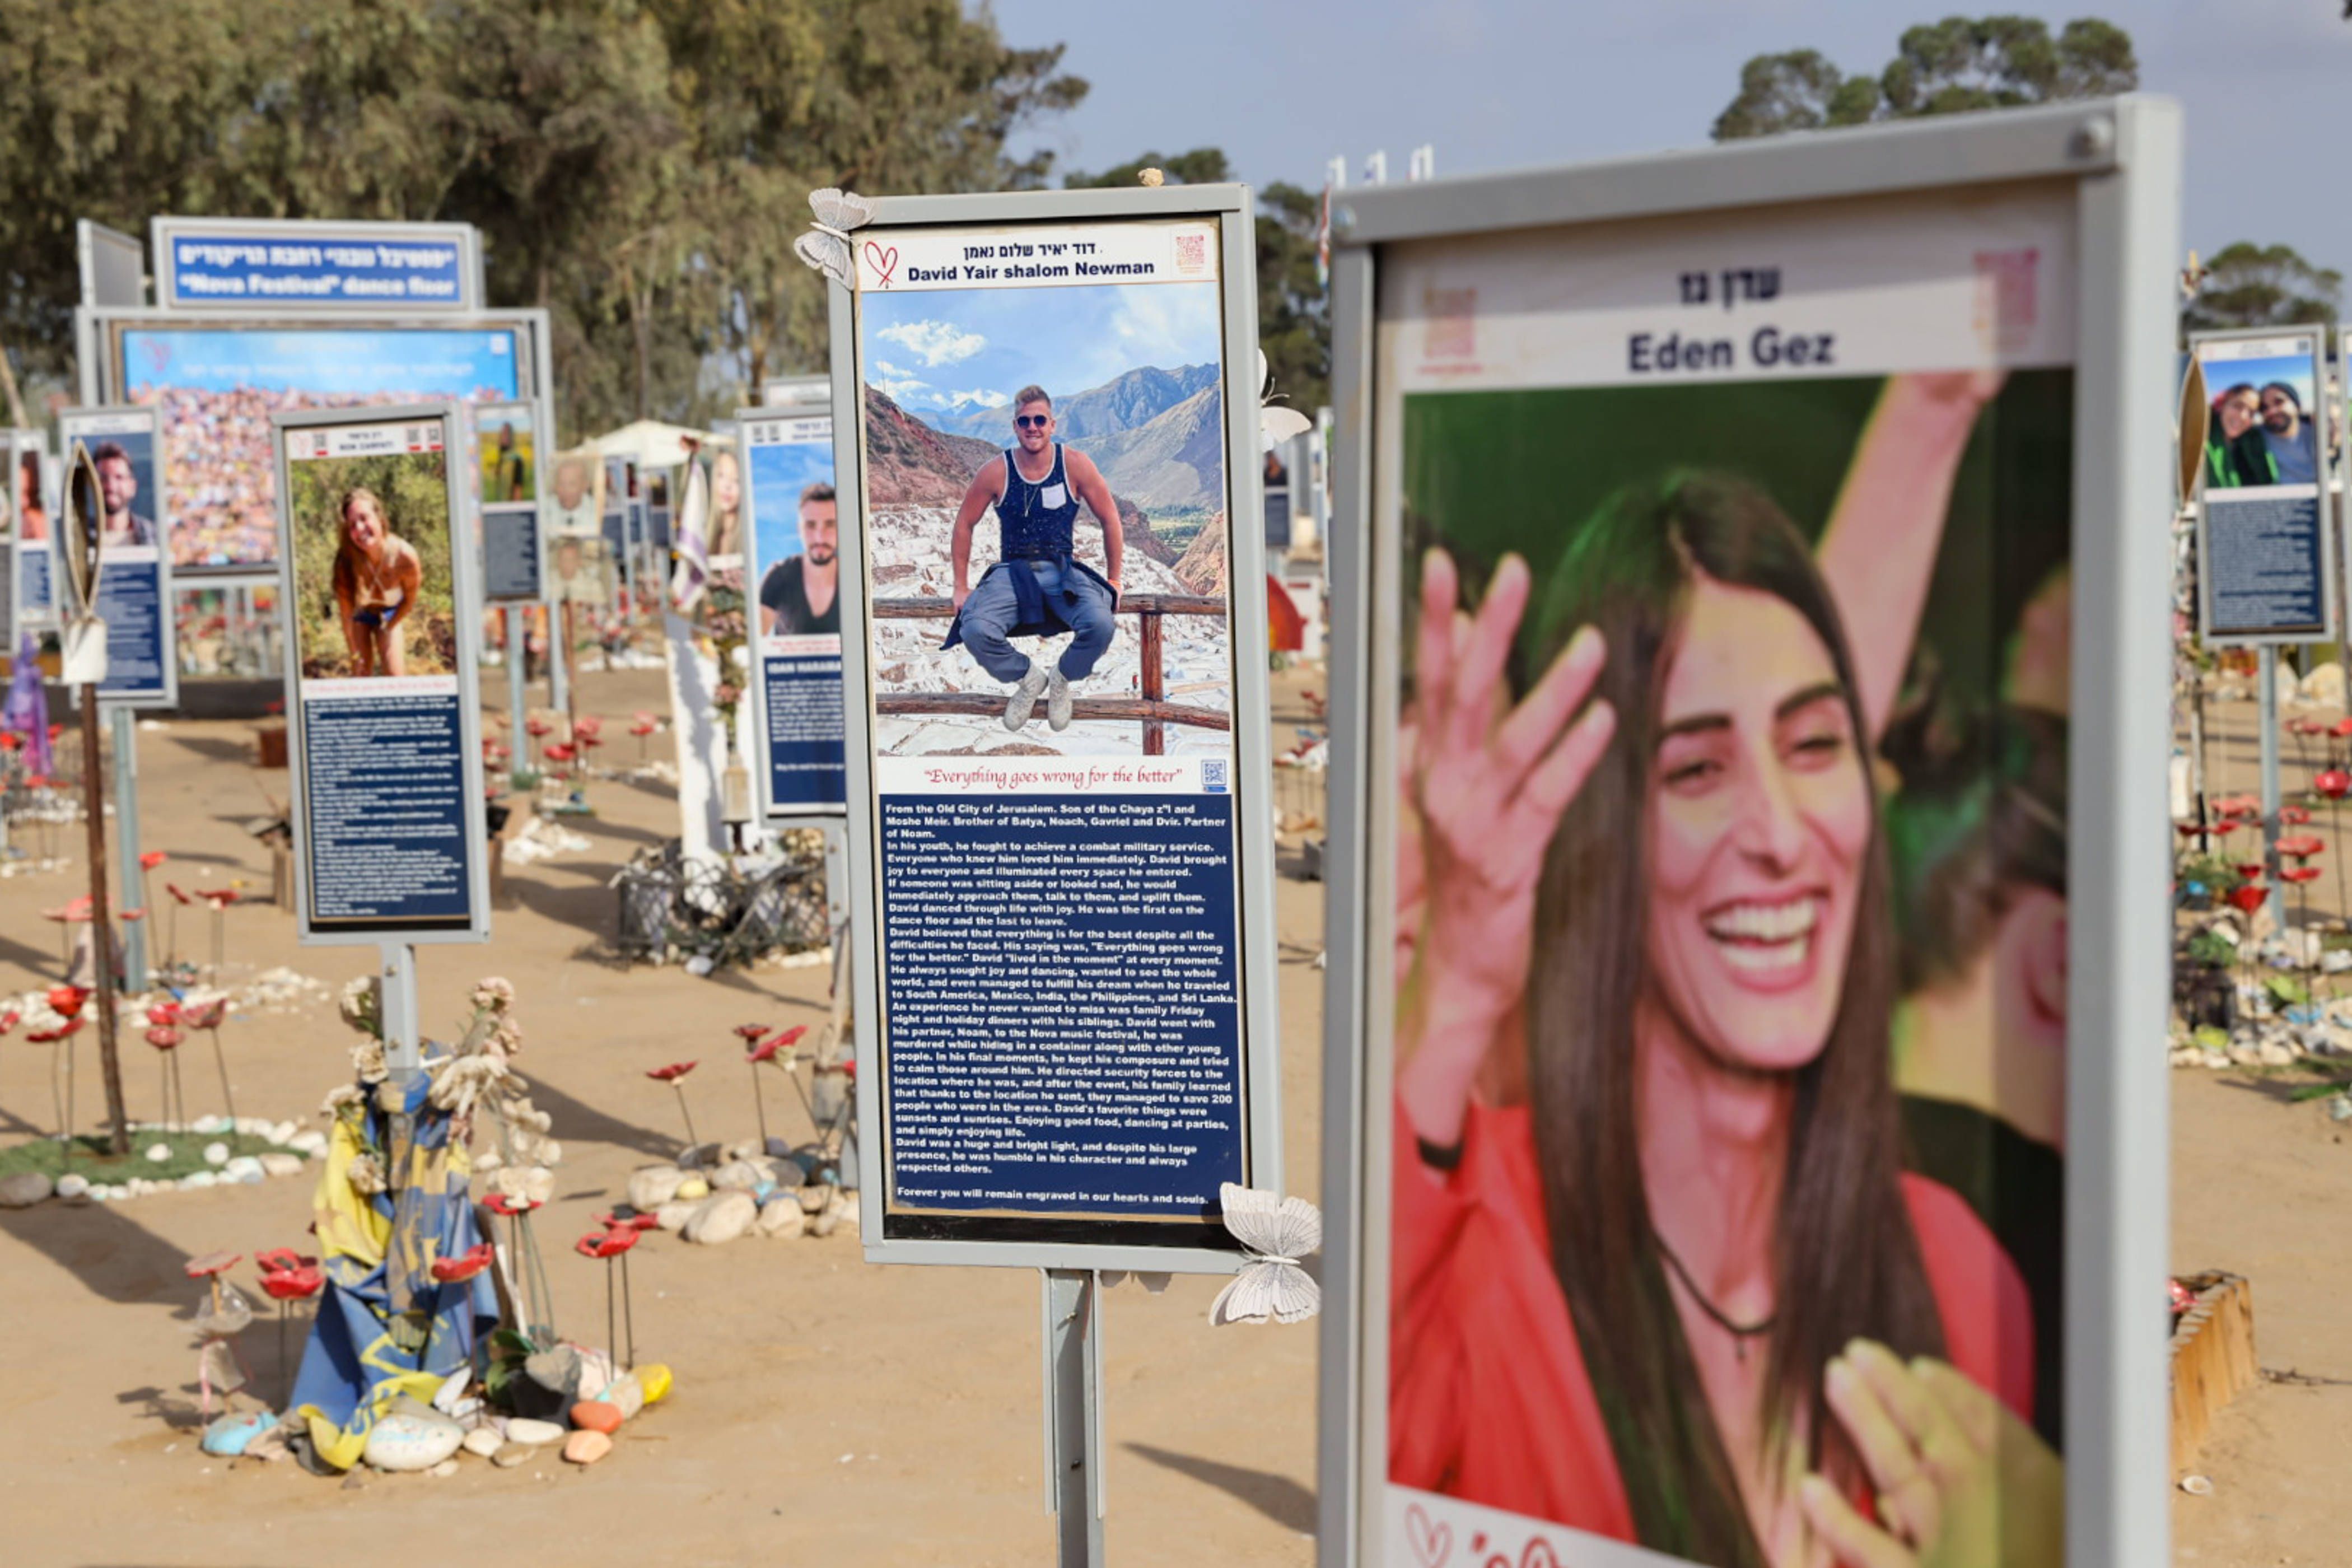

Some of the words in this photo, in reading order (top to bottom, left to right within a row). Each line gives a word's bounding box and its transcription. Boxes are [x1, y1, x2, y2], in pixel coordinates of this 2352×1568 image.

[964, 246, 993, 260] נאמן
[1000, 243, 1033, 257] שלום
[1038, 244, 1067, 255] יאיר
[1072, 244, 1095, 254] דוד
[909, 267, 956, 281] David
[963, 265, 998, 279] Yair
[1004, 264, 1068, 278] shalom
[1076, 262, 1154, 276] Newman
[342, 275, 405, 295] dance
[407, 274, 455, 296] floor
[1628, 328, 1733, 372] Eden
[1751, 325, 1836, 367] Gez
[923, 767, 1006, 789] "Everything
[1011, 771, 1039, 790] goes
[1043, 769, 1084, 789] wrong
[1088, 768, 1108, 790] for
[1113, 766, 1132, 782] the
[1137, 768, 1182, 783] better"
[885, 804, 914, 813] From
[916, 805, 934, 813] the
[936, 804, 955, 813] Old
[957, 804, 980, 815] City
[982, 804, 993, 813] of
[996, 804, 1057, 813] Jerusalem.
[1060, 804, 1081, 813] Son
[1083, 804, 1095, 813] of
[1098, 805, 1117, 813] the
[1119, 804, 1154, 815] Chaya
[1174, 804, 1195, 813] and
[885, 816, 921, 825] Moshe
[924, 816, 950, 825] Meir.
[953, 816, 994, 825] Brother
[996, 816, 1009, 825] of
[1049, 817, 1088, 827] Noach,
[1132, 817, 1153, 826] and
[1156, 816, 1181, 826] Dvir.
[1184, 817, 1226, 827] Partner
[886, 829, 897, 838] of
[901, 829, 935, 838] Noam.
[900, 842, 917, 850] his
[919, 842, 953, 852] youth,
[955, 842, 969, 850] he
[972, 842, 1007, 852] fought
[1009, 842, 1021, 851] to
[1024, 842, 1067, 851] achieve
[1079, 842, 1121, 851] combat
[1123, 842, 1166, 853] military
[1169, 842, 1214, 851] service.
[886, 853, 937, 865] Everyone
[939, 854, 964, 862] who
[965, 854, 996, 863] knew
[997, 854, 1019, 863] him
[1020, 854, 1051, 863] loved
[1052, 854, 1074, 863] him
[1076, 855, 1147, 866] immediately.
[1149, 855, 1181, 864] David
[1183, 855, 1227, 866] brought
[888, 903, 920, 912] David
[921, 903, 962, 912] danced
[964, 903, 1007, 914] through
[1009, 904, 1027, 912] life
[1056, 905, 1075, 915] joy.
[1077, 904, 1094, 913] He
[1121, 905, 1140, 914] the
[1142, 904, 1165, 913] first
[1186, 906, 1204, 914] the
[888, 916, 922, 924] dance
[925, 916, 950, 925] floor
[953, 916, 973, 925] and
[976, 916, 993, 925] the
[996, 916, 1016, 925] last
[1034, 917, 1067, 925] leave.
[889, 953, 905, 962] for
[908, 953, 926, 962] the
[972, 953, 1002, 962] David
[1052, 954, 1071, 963] the
[1140, 957, 1171, 966] every
[1174, 956, 1222, 965] moment.
[891, 990, 903, 998] to
[906, 990, 937, 998] South
[939, 990, 988, 1001] America,
[991, 991, 1034, 1001] Mexico,
[1035, 991, 1067, 1002] India,
[1069, 992, 1088, 1001] the
[1090, 992, 1155, 1003] Philippines,
[1157, 993, 1178, 1002] and
[1181, 993, 1197, 1002] Sri
[1199, 992, 1237, 1004] Lanka.
[894, 1088, 917, 1097] that
[919, 1089, 956, 1098] thanks
[972, 1090, 991, 1099] the
[993, 1090, 1038, 1100] location
[1057, 1092, 1085, 1102] sent,
[1087, 1092, 1112, 1103] they
[1114, 1093, 1165, 1104] managed
[1168, 1094, 1180, 1103] to
[1211, 1094, 1233, 1104] 200
[895, 1137, 926, 1147] David
[963, 1139, 990, 1150] huge
[992, 1140, 1013, 1149] and
[1016, 1140, 1048, 1152] bright
[1082, 1142, 1102, 1151] and
[1104, 1142, 1146, 1154] despite
[1149, 1144, 1166, 1152] his
[1168, 1144, 1197, 1155] large
[896, 1163, 950, 1174] respected
[954, 1164, 992, 1173] others.
[896, 1187, 938, 1197] Forever
[940, 1189, 960, 1199] you
[962, 1188, 983, 1197] will
[984, 1189, 1023, 1198] remain
[1025, 1191, 1076, 1202] engraved
[1078, 1192, 1090, 1200] in
[1112, 1192, 1150, 1202] hearts
[1151, 1194, 1173, 1203] and
[1175, 1194, 1208, 1204] souls.
